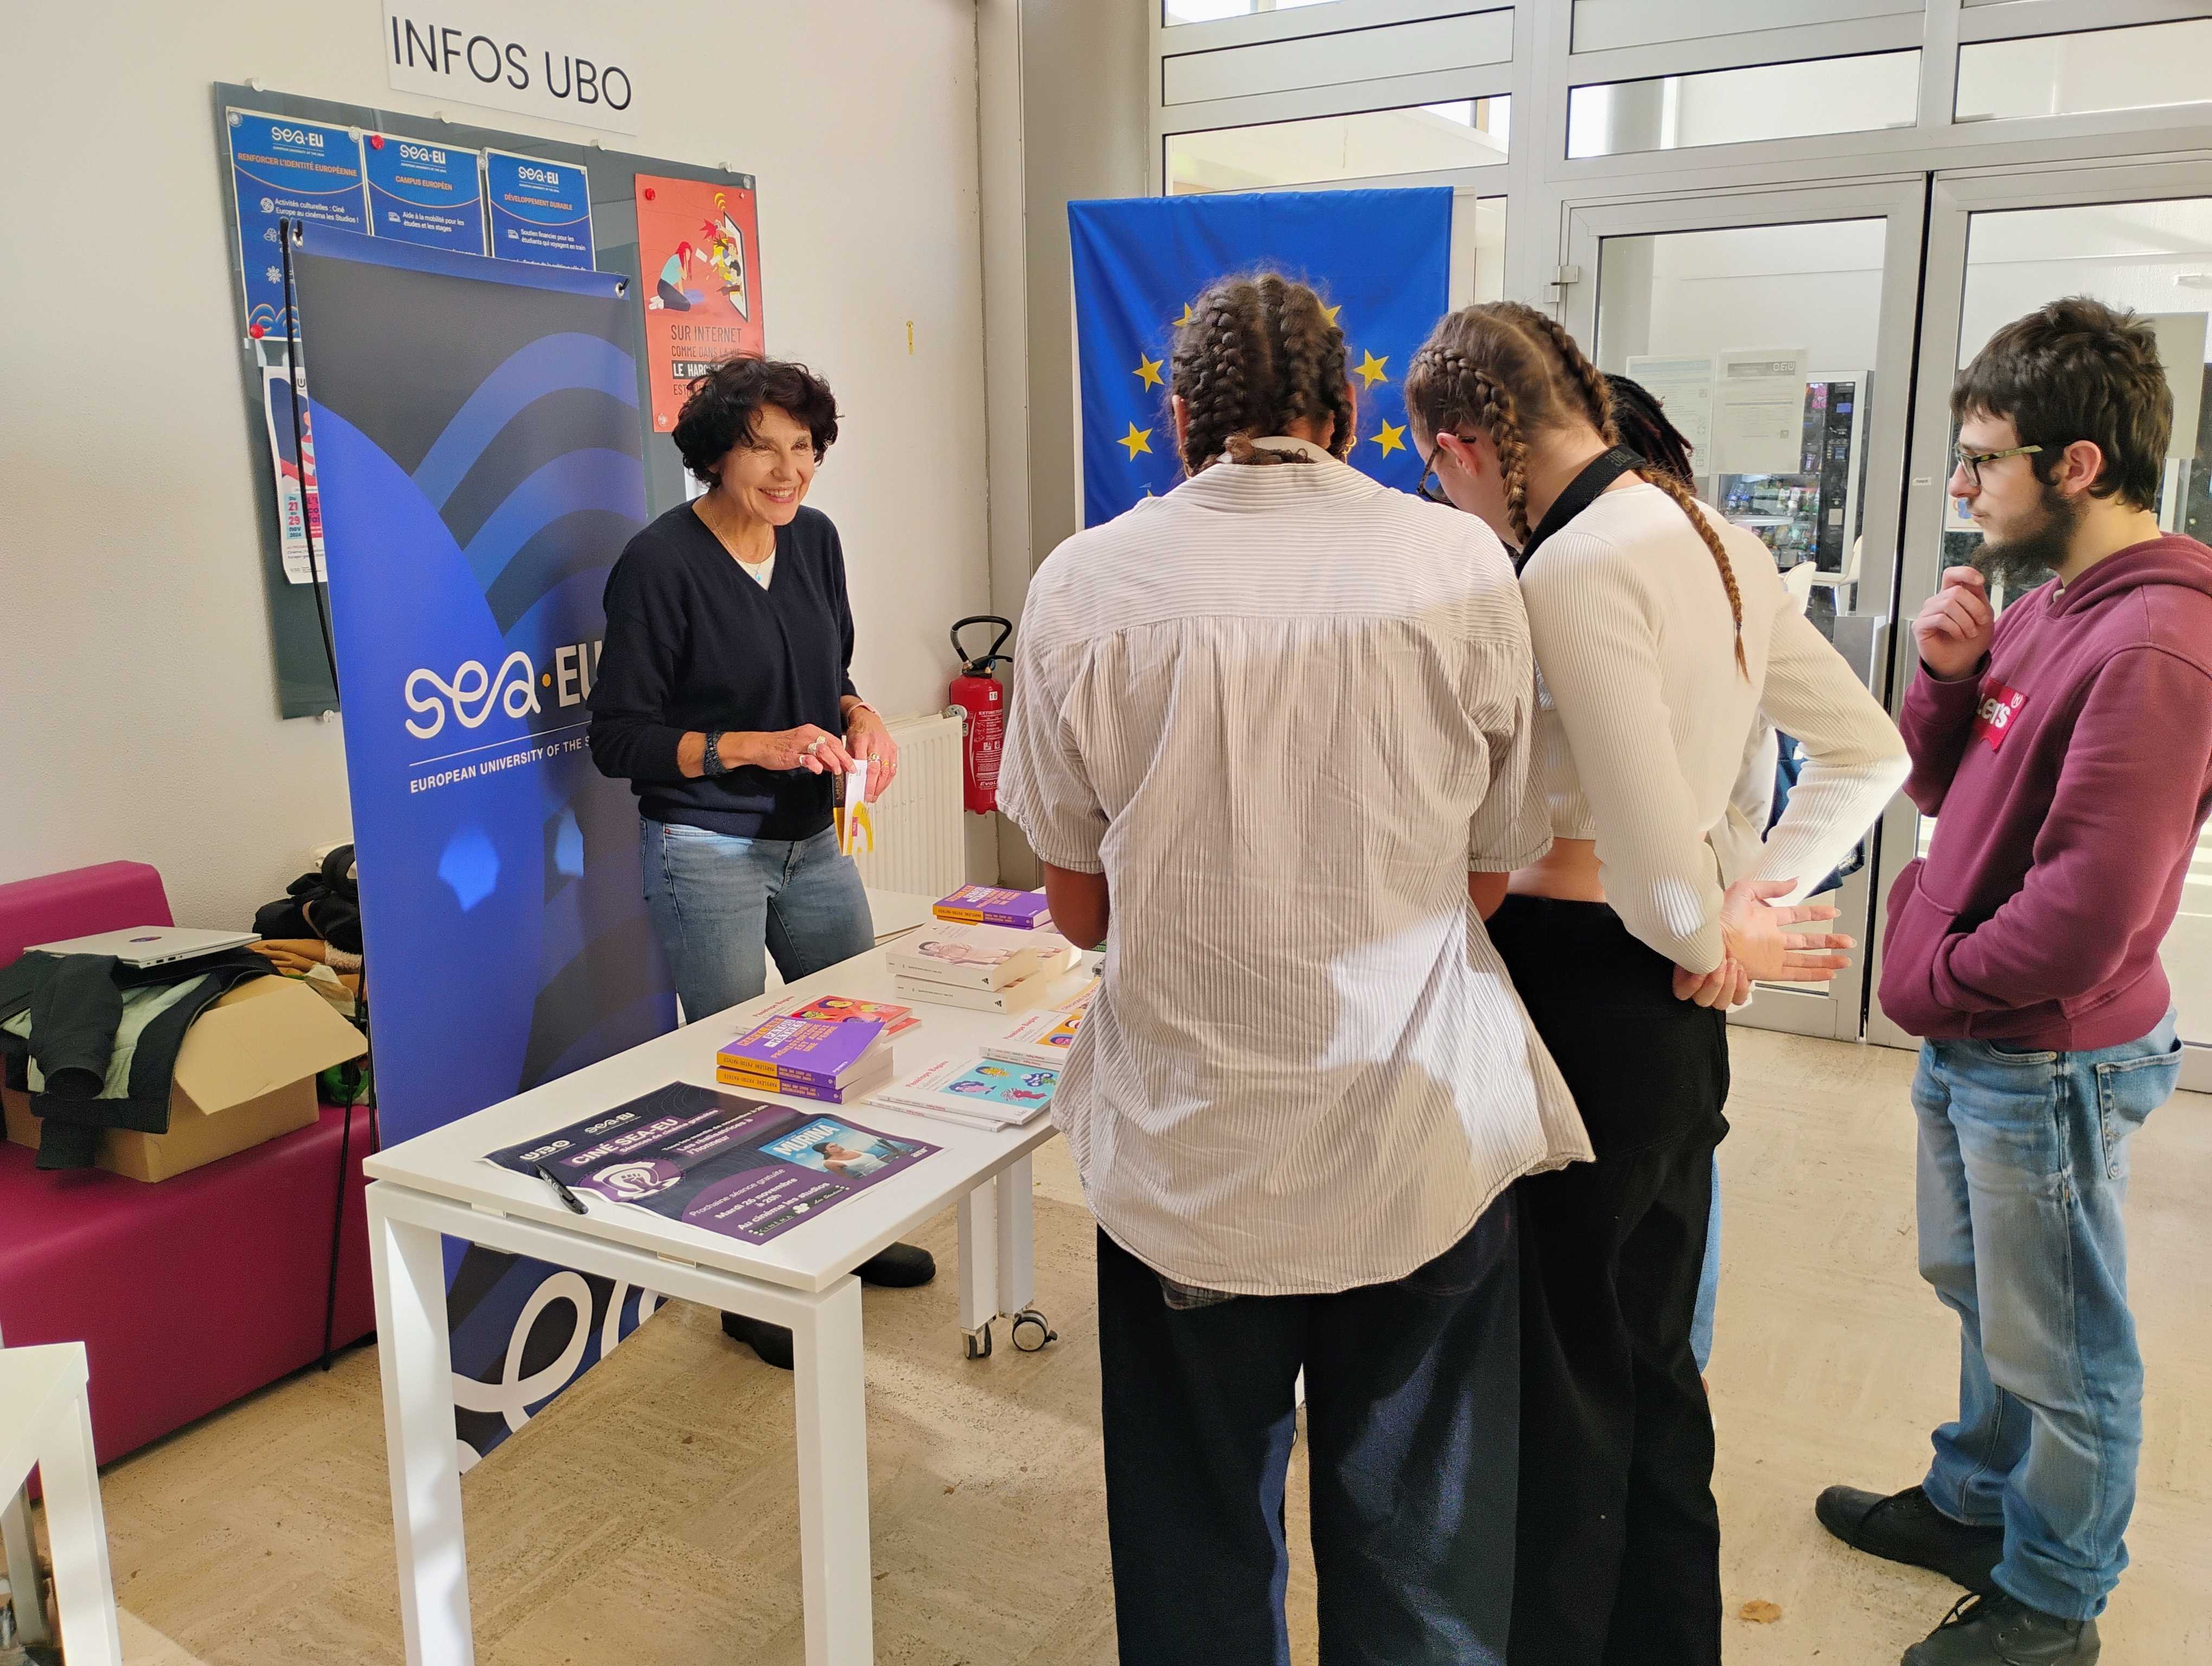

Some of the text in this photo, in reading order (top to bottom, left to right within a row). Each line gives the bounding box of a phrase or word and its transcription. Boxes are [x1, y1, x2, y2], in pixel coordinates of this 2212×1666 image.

[391, 15, 632, 111] INFOS UBO
[237, 152, 357, 177] RENFORCER L'IDENTITÉ EUROPÉENNE
[395, 175, 453, 191] CAMPUS EUROPÉEN
[274, 198, 299, 208] Activités
[300, 201, 329, 212] culturelles
[332, 204, 345, 214] Ciné
[504, 193, 574, 211] DÉVELOPPEMENT DURABLE
[275, 208, 296, 217] Europe
[305, 209, 325, 218] cinéma
[335, 213, 356, 223] Studios
[425, 214, 445, 223] mobilité
[403, 220, 421, 228] études
[435, 225, 452, 233] stages
[520, 228, 538, 237] Soutien
[538, 230, 557, 240] financier
[521, 237, 543, 245] étudiants
[550, 242, 569, 251] voyagent
[671, 324, 742, 343] SUR INTERNET
[671, 345, 697, 357] COMME
[699, 347, 718, 358] DANS
[673, 363, 684, 377] LE
[673, 383, 687, 395] EST
[288, 501, 298, 511] 21
[288, 515, 301, 526] 29
[410, 764, 477, 794] EUROPEAN
[479, 747, 544, 776] UNIVERSITY
[546, 744, 561, 758] OF
[562, 739, 583, 753] THE
[766, 1020, 794, 1038] PATOU
[768, 1022, 805, 1046] -MATHIS
[794, 1025, 831, 1050] EST AUSSI
[770, 1023, 822, 1059] PRÉHISTORIQUE
[802, 1025, 839, 1052] UNE FEMME
[724, 1057, 754, 1068] PATOU-MATHIS
[724, 1074, 755, 1085] PATOU-MATHIS
[661, 1122, 689, 1136] cinéma
[687, 1110, 719, 1125] gratuites
[721, 1112, 752, 1126] novembre
[571, 1143, 619, 1165] CINÉ
[614, 1118, 679, 1147] SEA-EU
[676, 1142, 696, 1152] Les
[695, 1120, 747, 1145] réalisatrices
[686, 1135, 730, 1155] l'honneur
[772, 1124, 841, 1156] MURINA
[519, 1139, 570, 1161] UBO
[689, 1167, 786, 1217] Prochaine séance gratuite
[714, 1176, 799, 1219] Mardi 26 novembre
[761, 1193, 782, 1206] 20h
[737, 1181, 831, 1231] Au cinéma les studios
